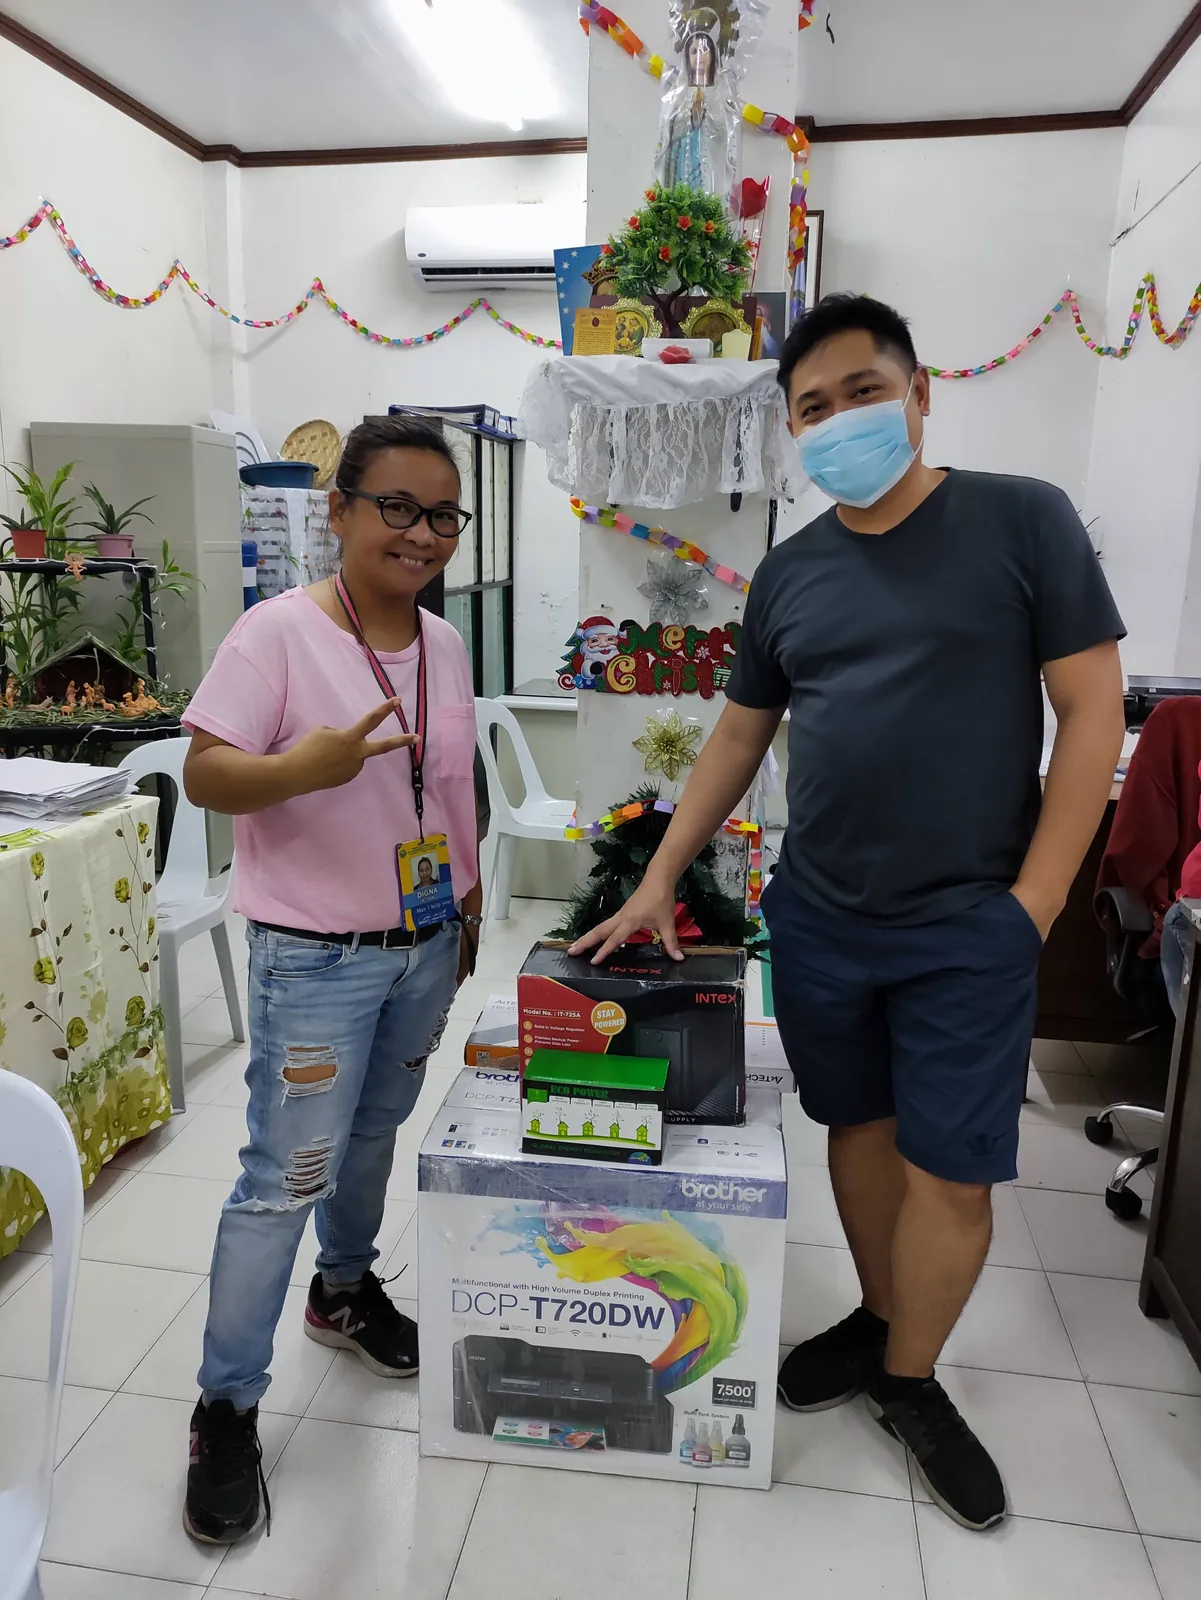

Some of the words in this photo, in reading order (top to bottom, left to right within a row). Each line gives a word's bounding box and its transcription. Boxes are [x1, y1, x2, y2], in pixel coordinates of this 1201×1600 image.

[417, 887, 438, 899] DIGNA
[596, 1009, 616, 1019] STAY
[594, 1018, 625, 1029] POWERED
[550, 1084, 570, 1096] ECO
[573, 1087, 609, 1098] POWER
[681, 1179, 768, 1203] brother
[708, 1201, 730, 1210] your
[731, 1202, 751, 1212] side
[531, 1284, 550, 1293] High
[551, 1286, 581, 1295] Volume
[583, 1288, 611, 1298] Duplex
[613, 1291, 645, 1301] Printing
[452, 1289, 666, 1330] DCP-T720DW
